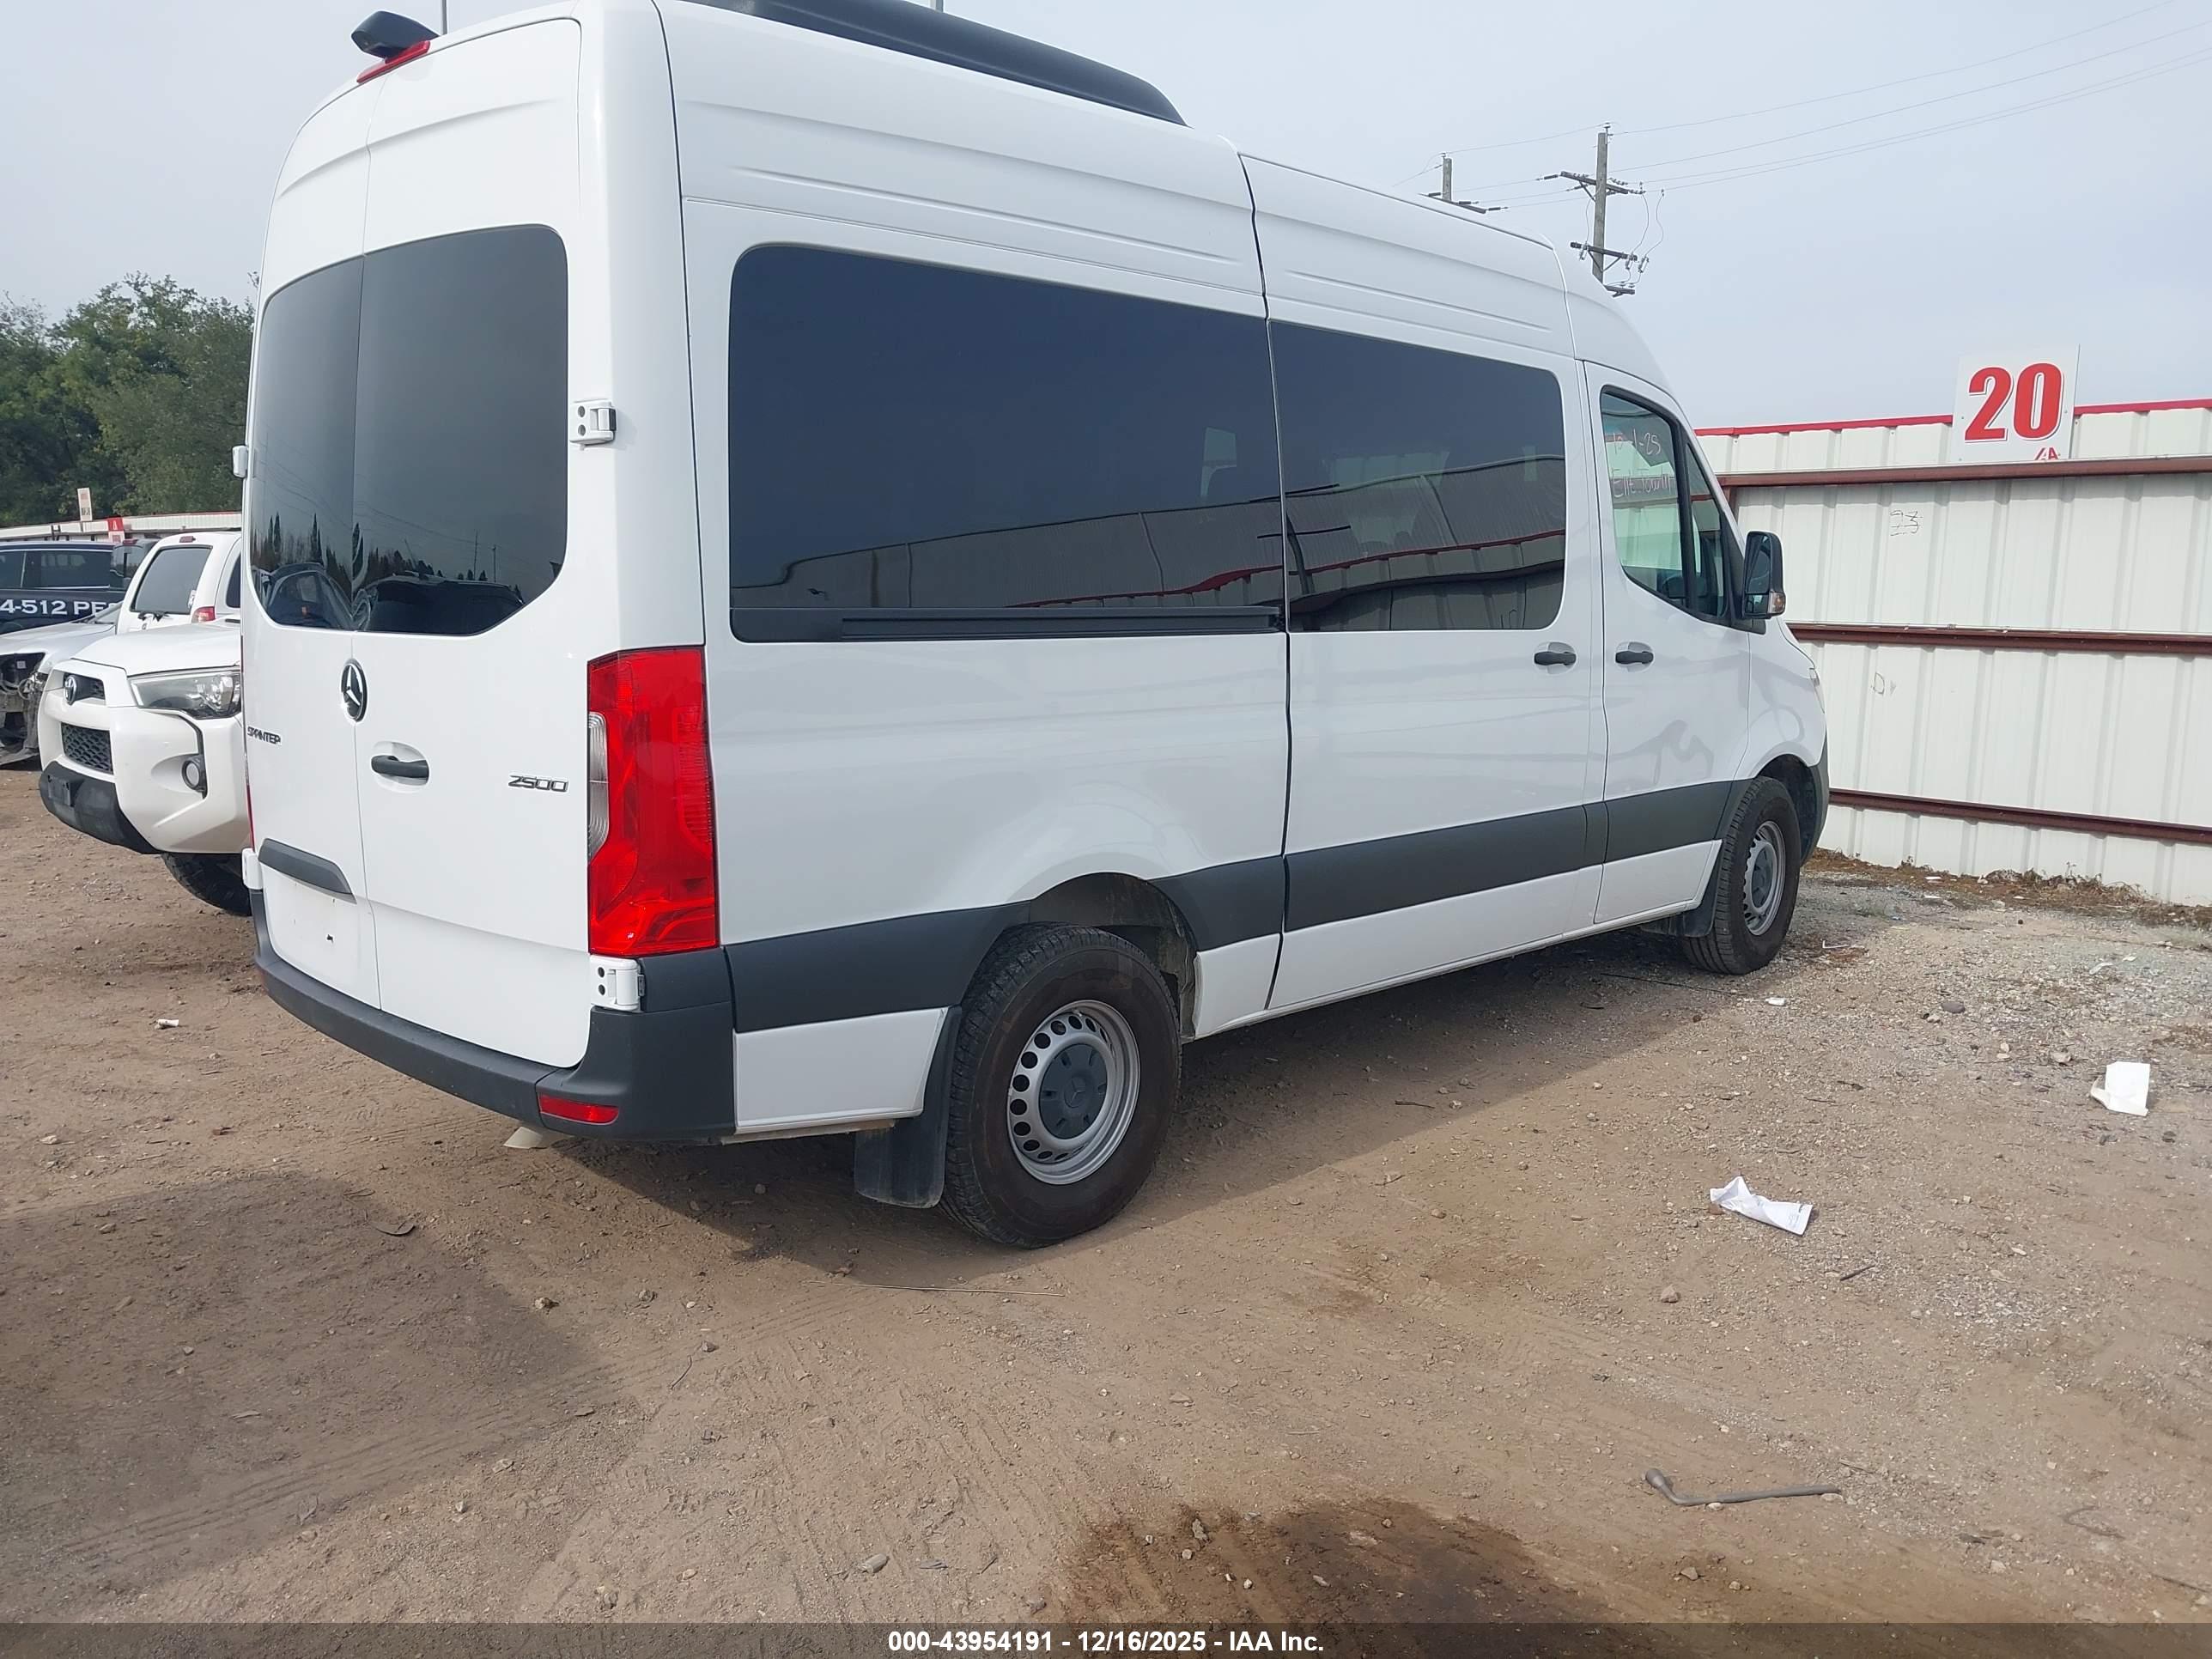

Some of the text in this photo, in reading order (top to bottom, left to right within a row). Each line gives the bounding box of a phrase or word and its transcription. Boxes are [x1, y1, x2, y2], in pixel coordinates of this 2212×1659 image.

[1965, 362, 2064, 443] 20
[0, 599, 68, 615] 4-512
[508, 775, 568, 793] 2500
